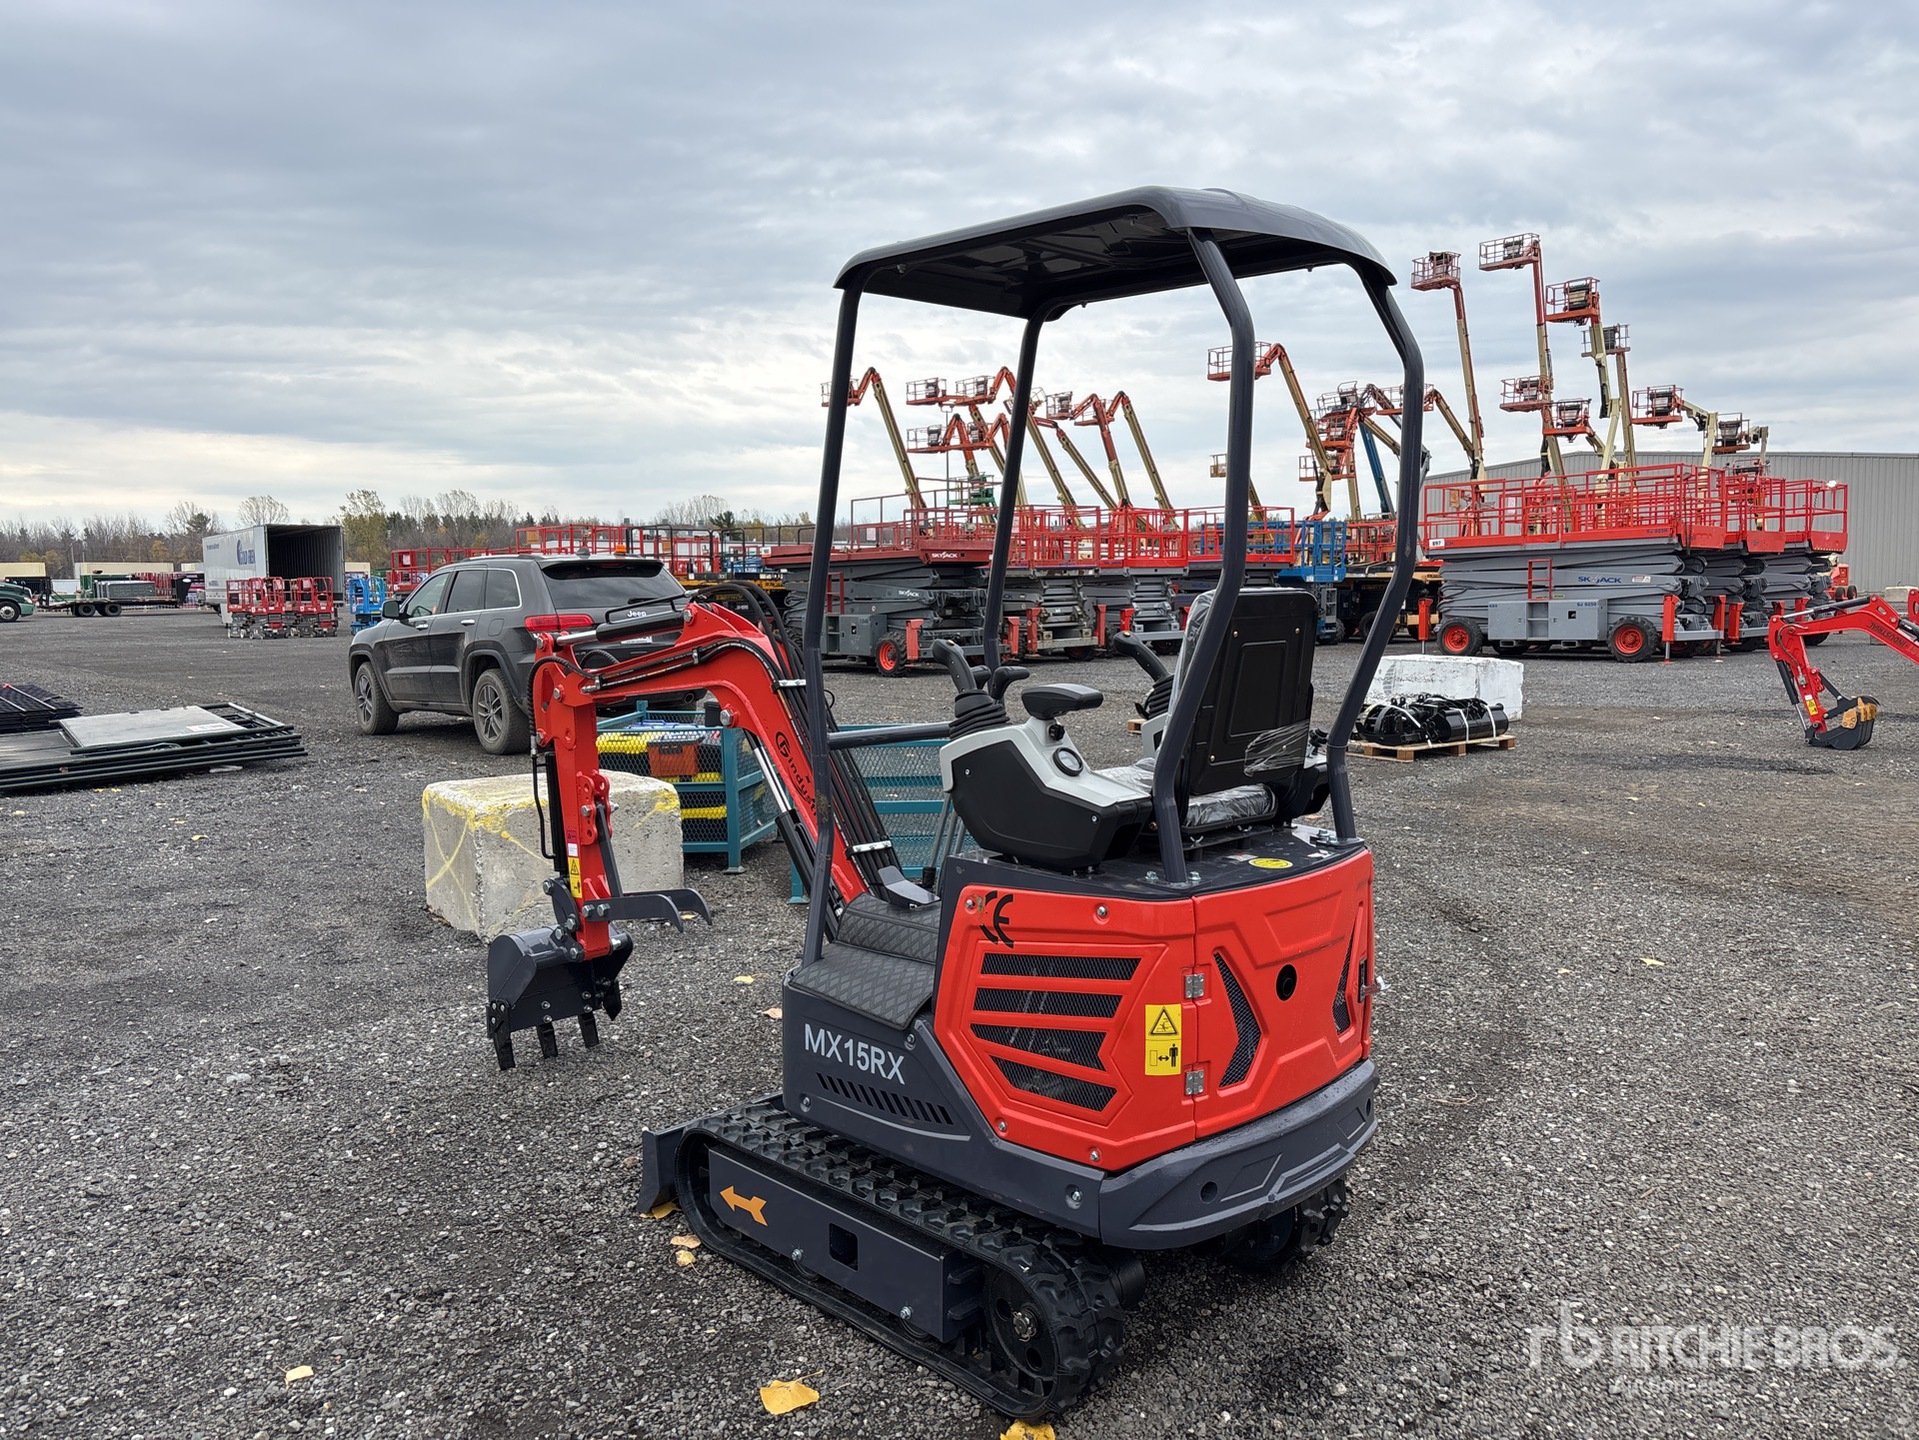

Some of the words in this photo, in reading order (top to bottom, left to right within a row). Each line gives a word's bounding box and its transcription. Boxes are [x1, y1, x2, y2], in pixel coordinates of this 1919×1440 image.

[931, 551, 958, 559] SKYJACK
[1577, 575, 1622, 584] SKYJACK
[898, 589, 920, 597] SKYJACK
[979, 890, 1014, 948] CE
[804, 1023, 905, 1085] MX15RX
